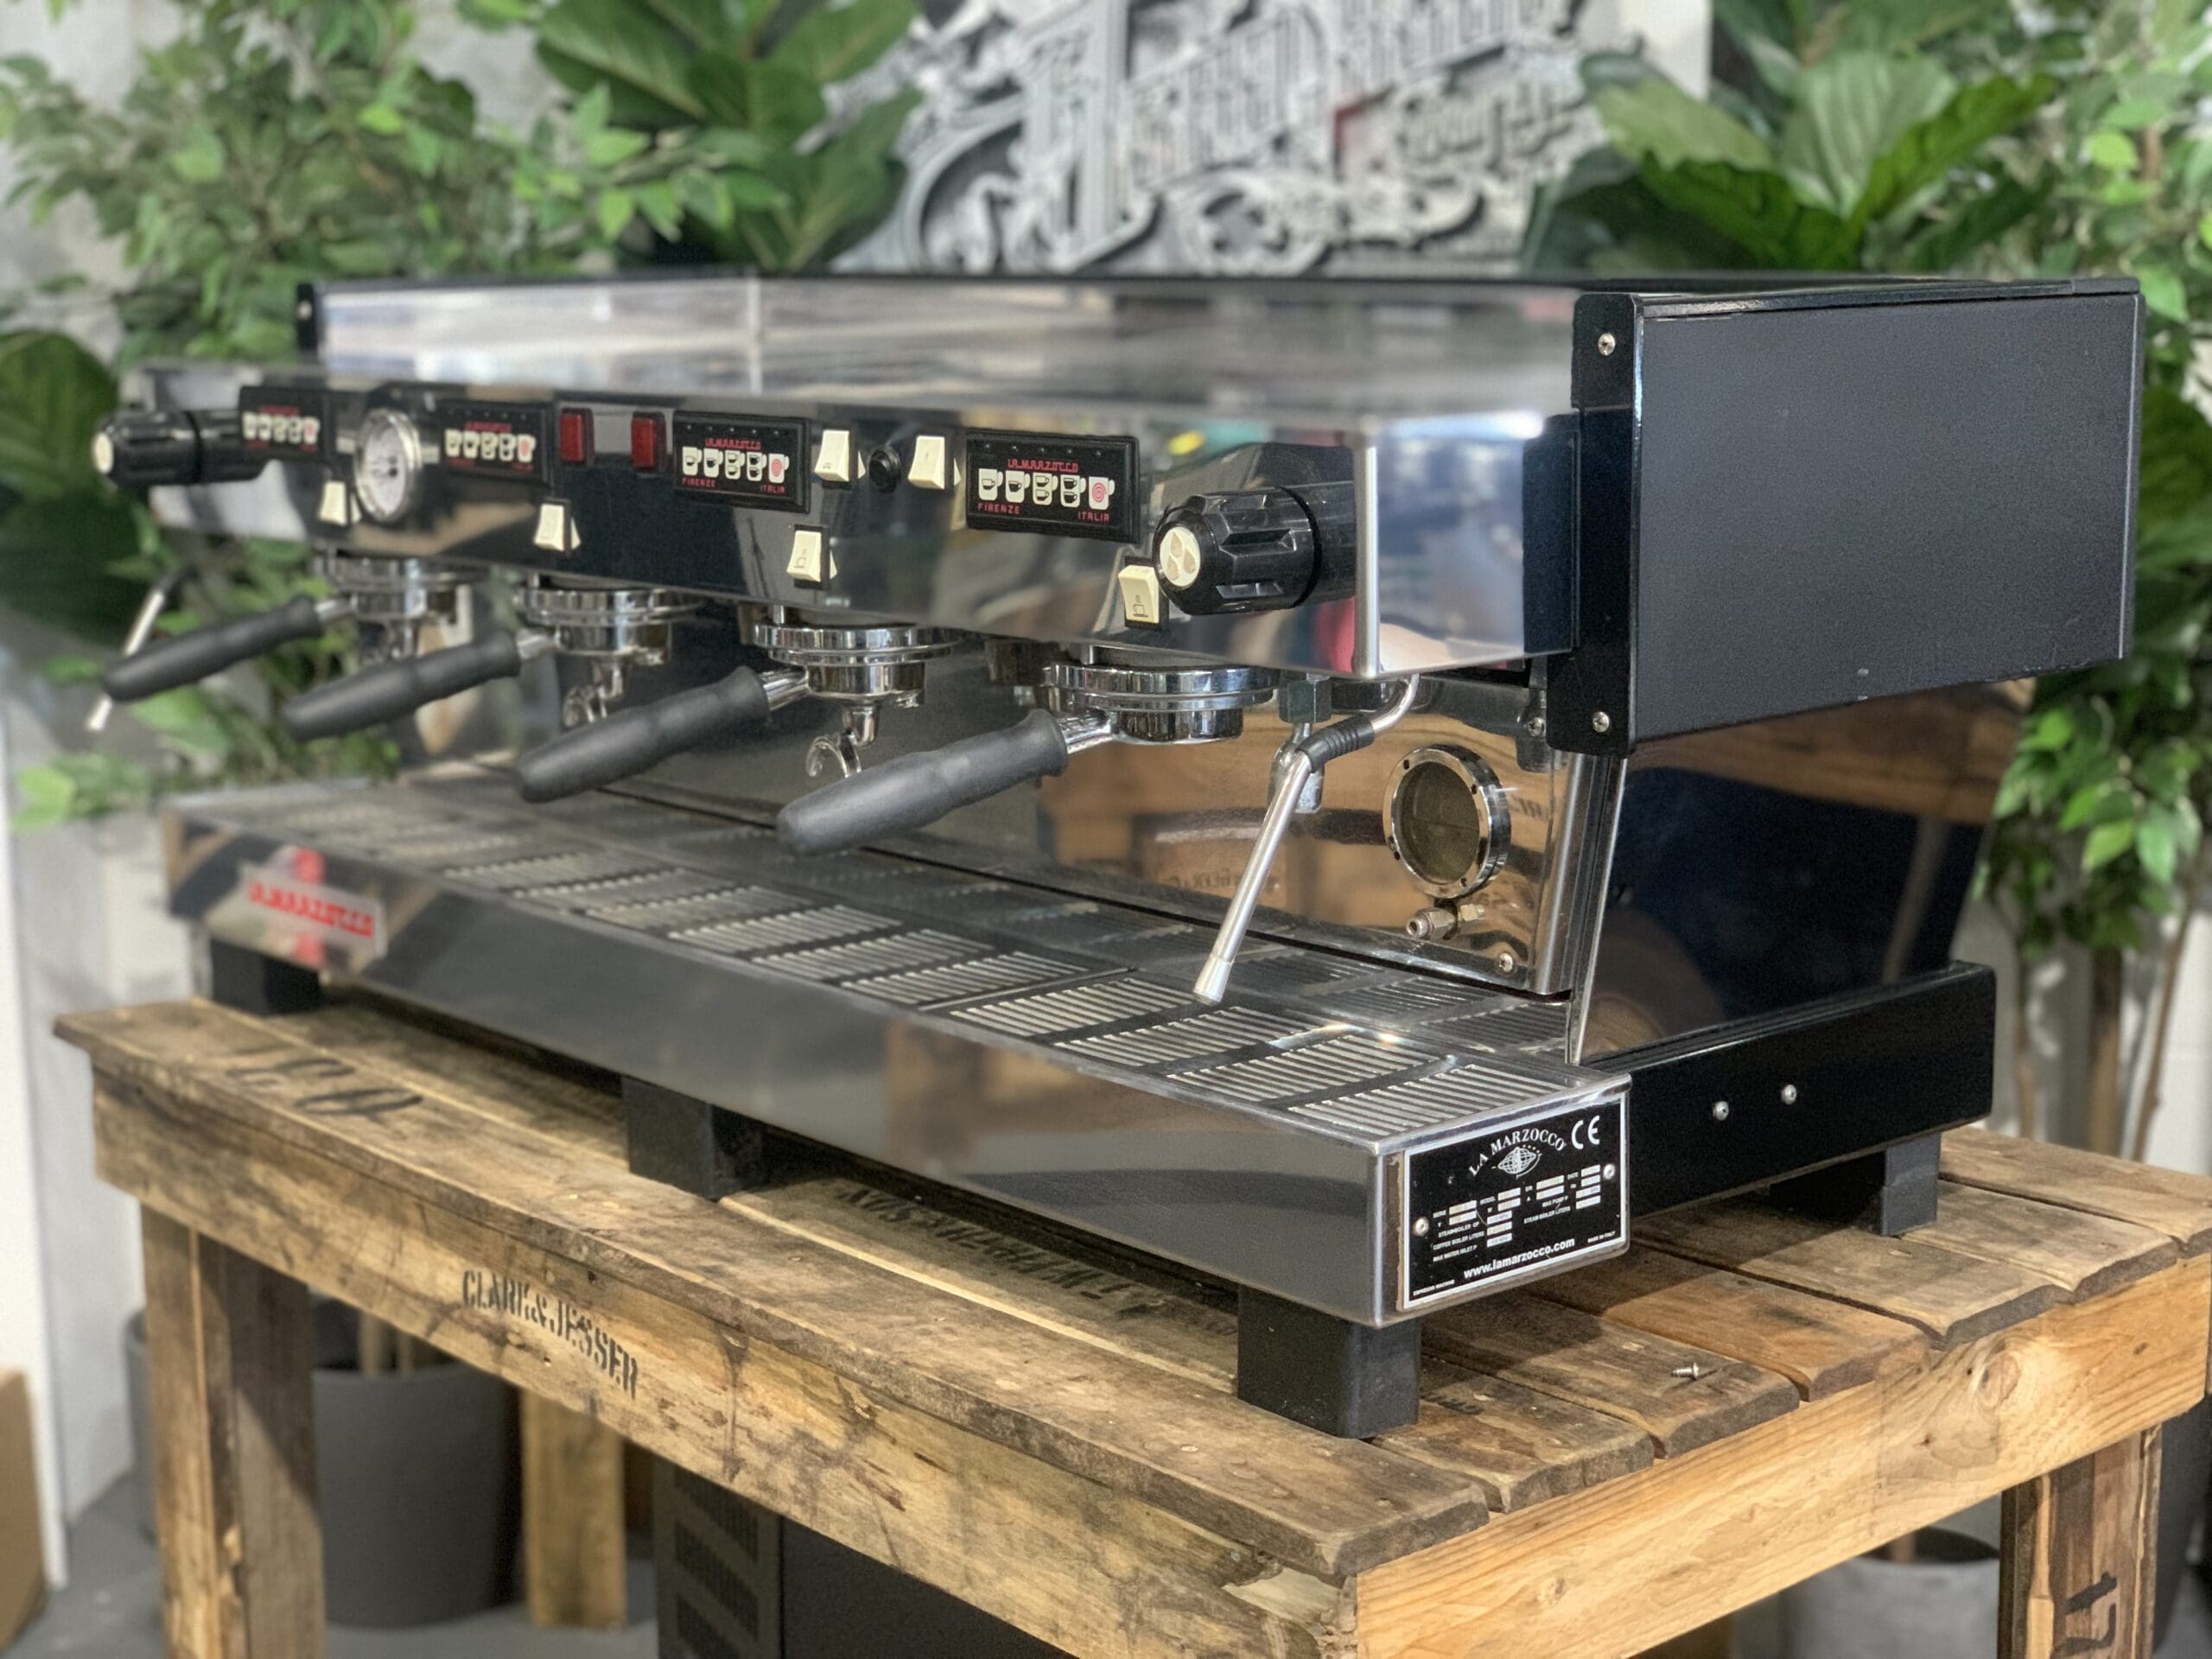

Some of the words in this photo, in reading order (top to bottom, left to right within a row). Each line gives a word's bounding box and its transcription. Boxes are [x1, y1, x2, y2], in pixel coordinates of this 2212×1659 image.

[977, 503, 1020, 514] FIRENZE
[1077, 512, 1110, 522] ITALIA
[1469, 1153, 1490, 1177] LA
[1490, 1128, 1565, 1155] MARZOCCO
[1463, 1238, 1575, 1279] www.lamarzocco.com
